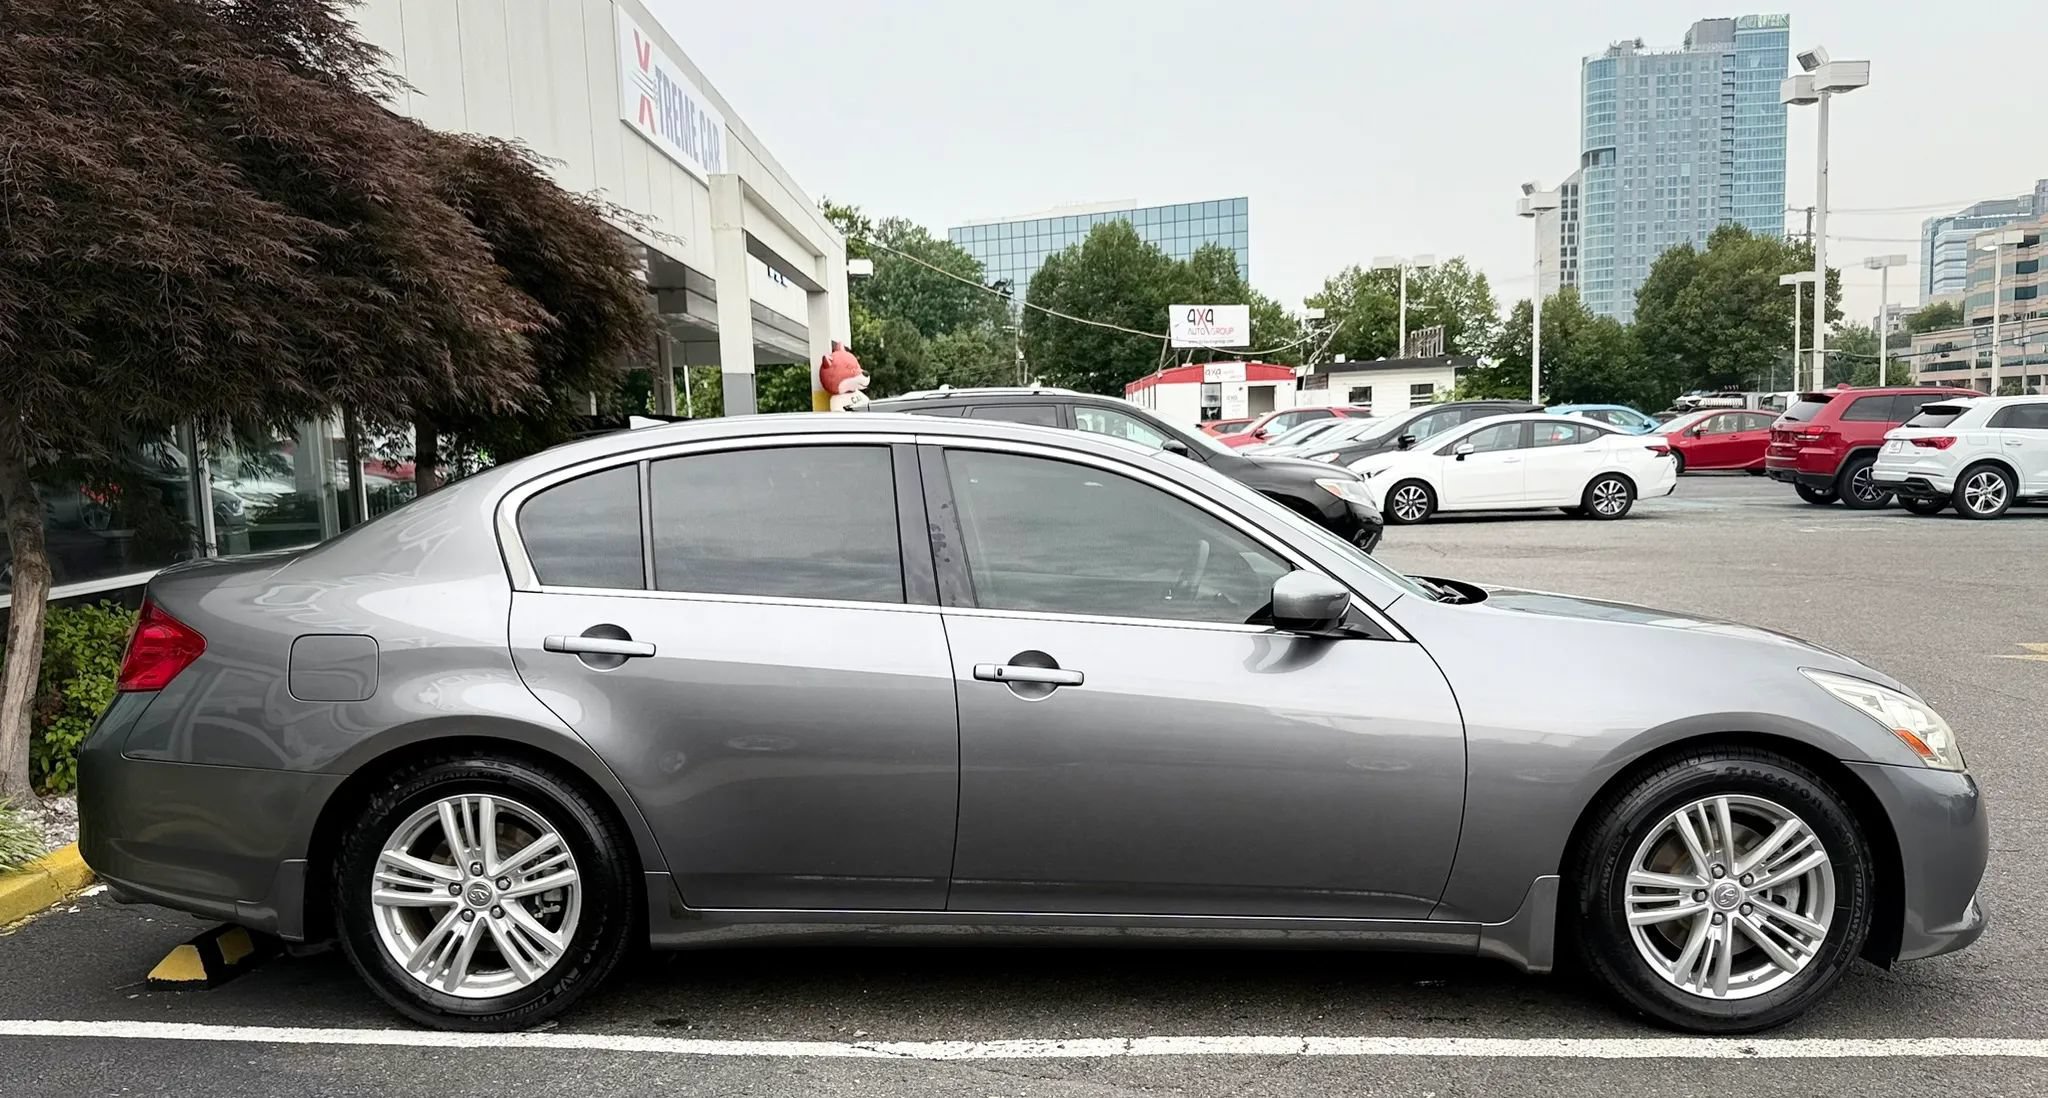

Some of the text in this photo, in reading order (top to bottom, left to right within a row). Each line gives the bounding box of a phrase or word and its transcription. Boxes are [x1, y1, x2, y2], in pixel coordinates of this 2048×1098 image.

[700, 110, 721, 174] CAR
[1188, 327, 1234, 336] AUTO GROUP
